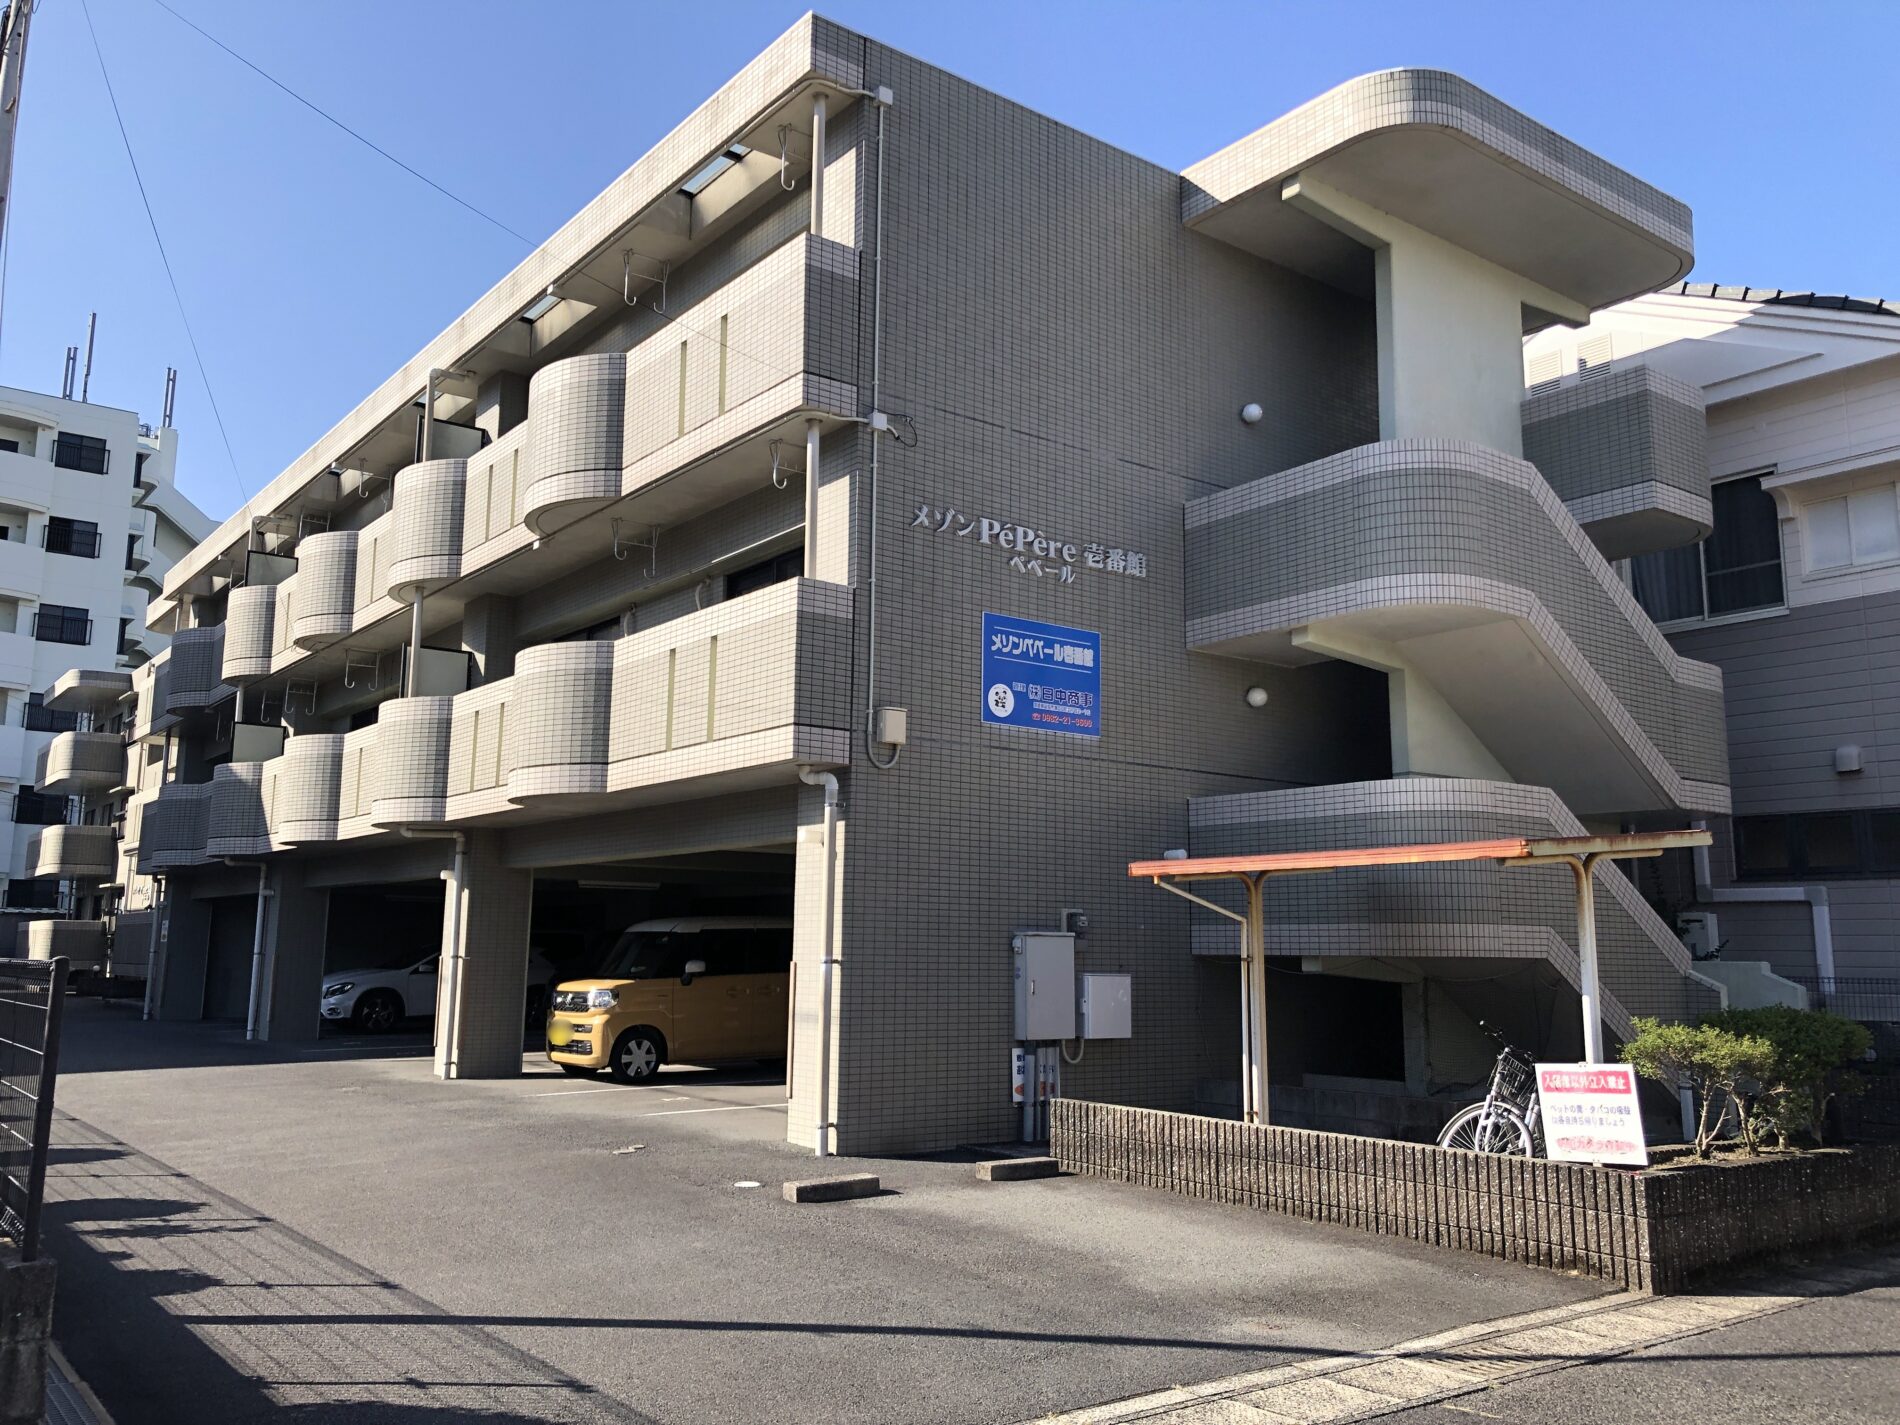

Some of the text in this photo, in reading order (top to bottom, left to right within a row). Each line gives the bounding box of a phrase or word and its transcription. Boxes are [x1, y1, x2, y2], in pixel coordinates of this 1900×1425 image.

[910, 504, 976, 537] メゾン
[979, 516, 1078, 563] PéPère
[1008, 555, 1077, 585] ペペール
